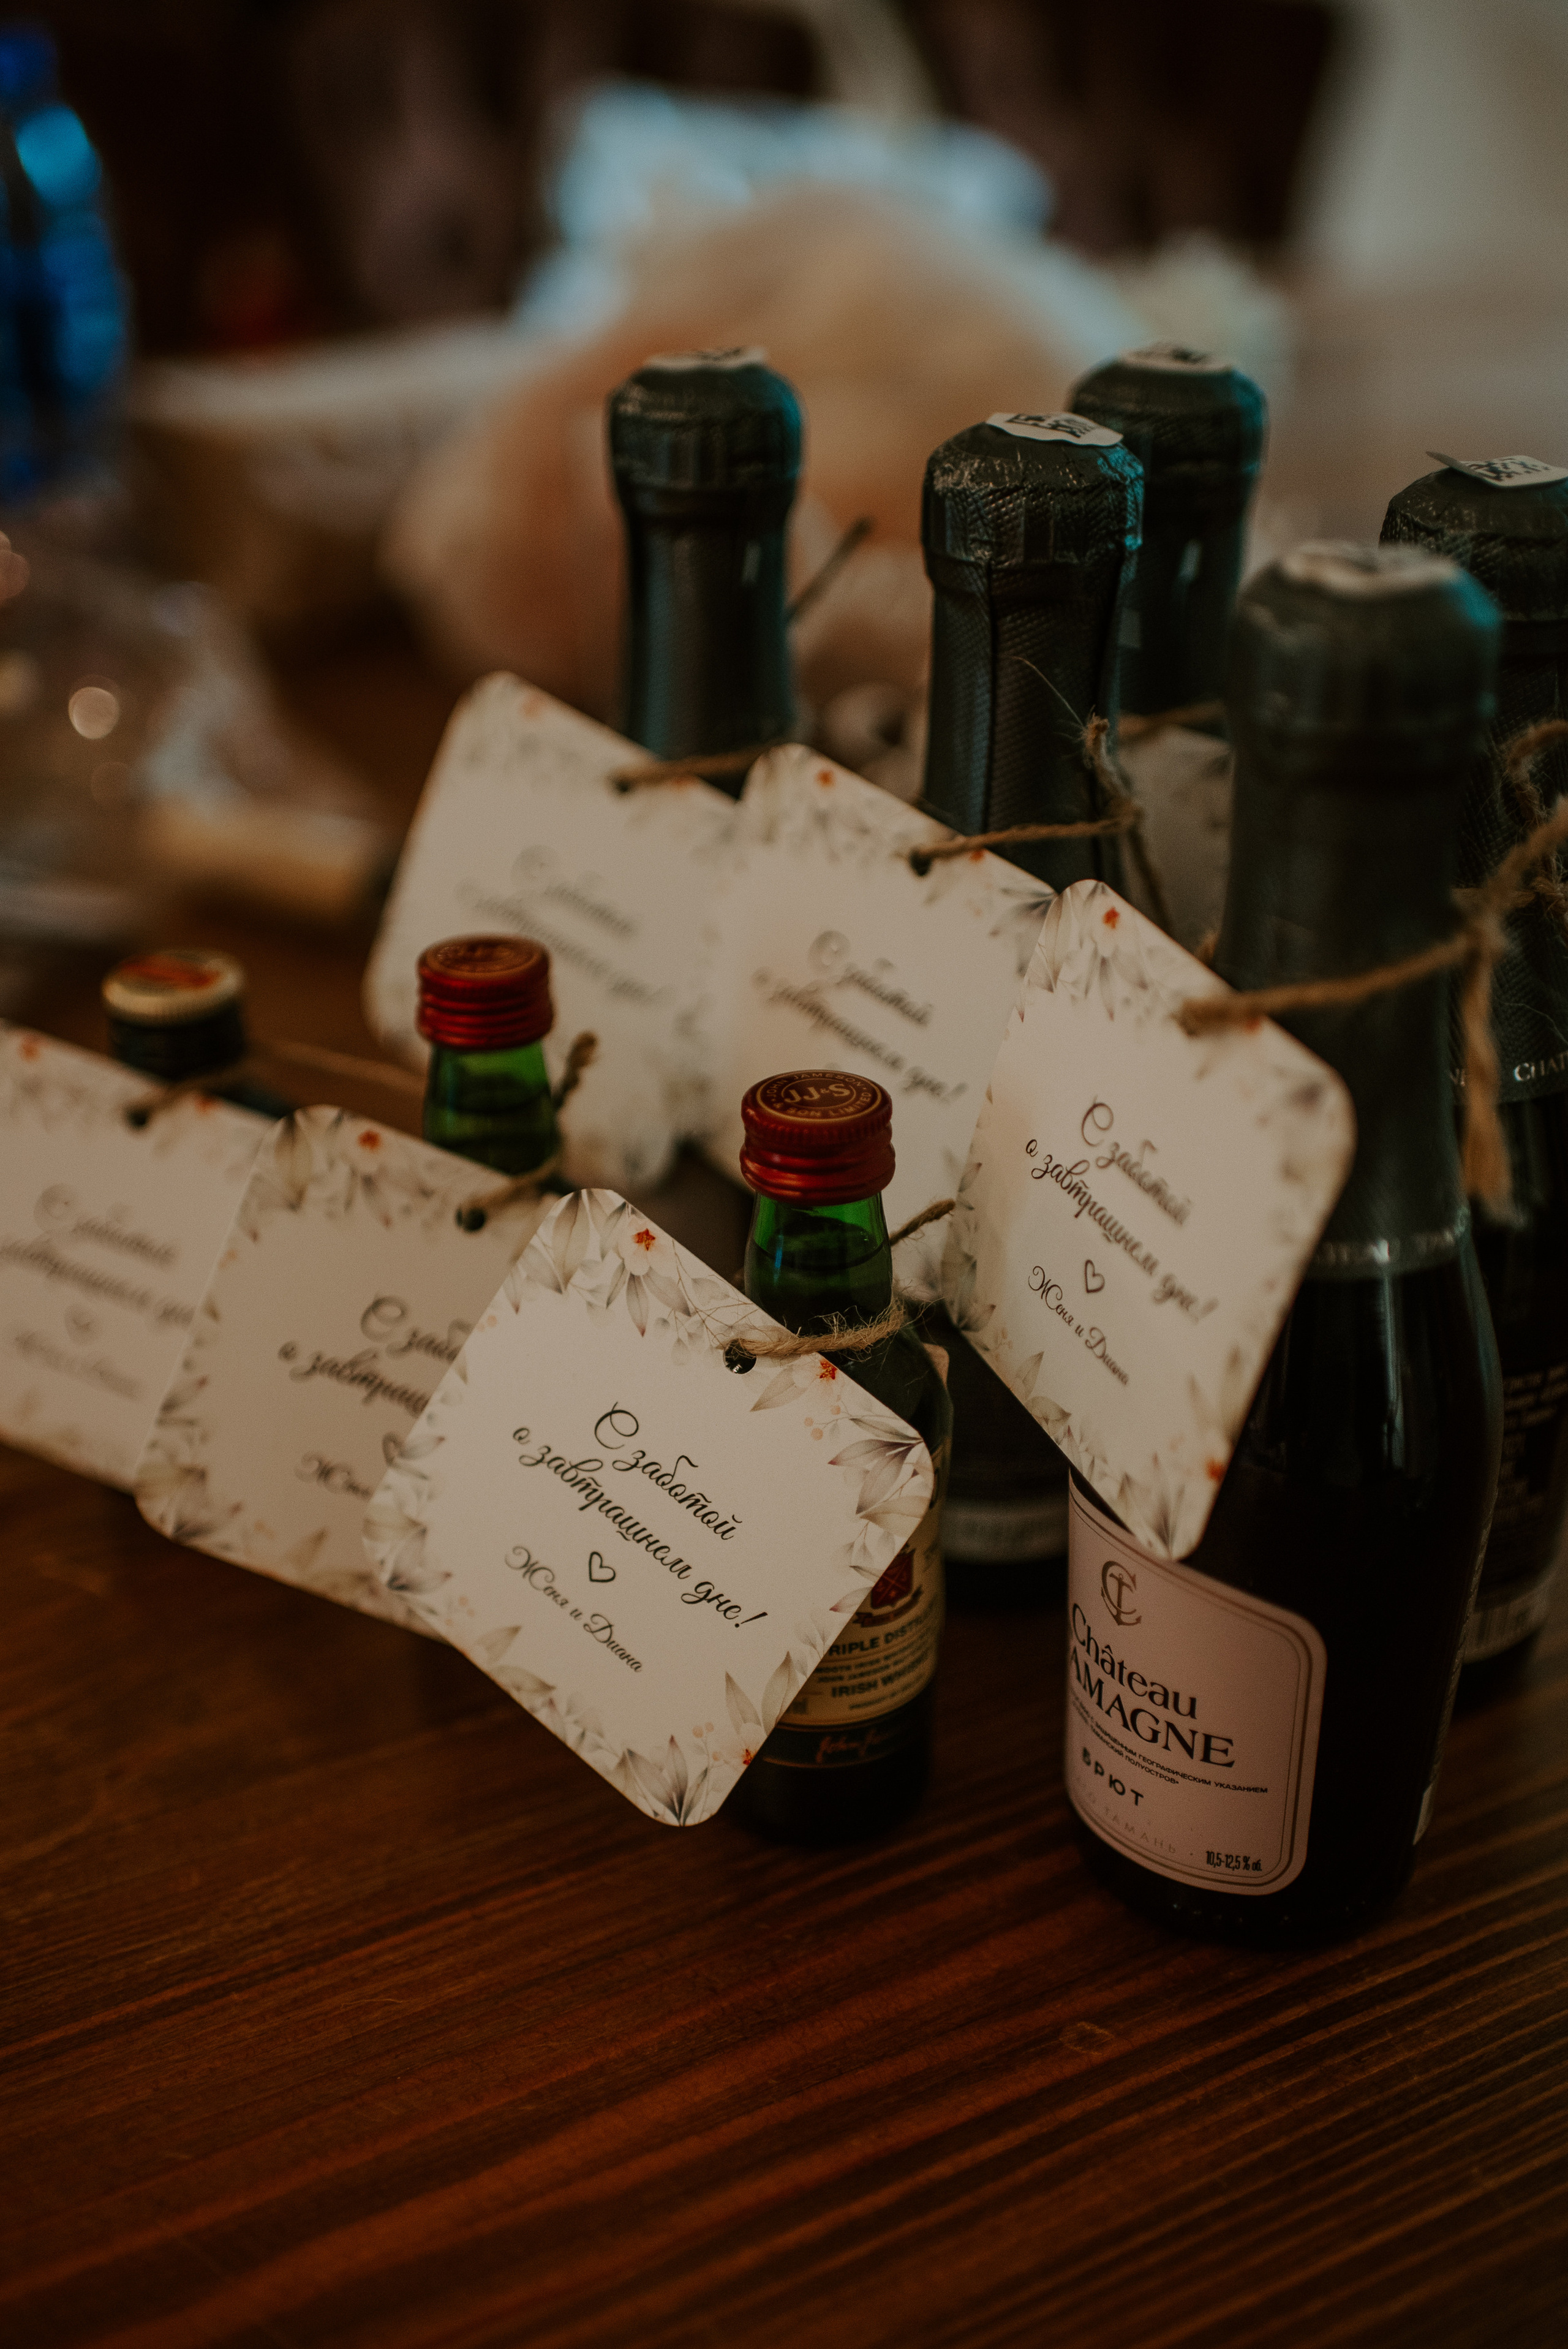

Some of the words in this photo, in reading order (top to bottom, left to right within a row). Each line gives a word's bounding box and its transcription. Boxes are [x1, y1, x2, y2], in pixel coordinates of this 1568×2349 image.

[766, 1080, 788, 1098] JOHN
[794, 1073, 864, 1087] JAMESON
[829, 1092, 872, 1116] LIMITED
[1082, 1095, 1114, 1148] С
[1025, 1139, 1039, 1157] о
[1031, 1154, 1159, 1277] завтрашнем
[1028, 1265, 1074, 1326] Женя
[1075, 1325, 1085, 1337] и
[513, 1427, 531, 1445] о
[594, 1402, 639, 1450] С
[518, 1445, 690, 1580] завтрашнем
[612, 1450, 742, 1540] заботой
[505, 1546, 569, 1608] Женя
[570, 1609, 582, 1621] и
[583, 1613, 642, 1673] Диана
[680, 1581, 768, 1628] дне!
[828, 1636, 880, 1655] RIPLE
[1072, 1603, 1197, 1719] Château
[1083, 1747, 1144, 1806] БРЮТ
[1139, 1754, 1212, 1786] ГЕОГРАФИЧЕСКИМ
[1214, 1781, 1268, 1794] УКАЗАНИЕМ
[1206, 1850, 1241, 1871] 10,5-12,5
